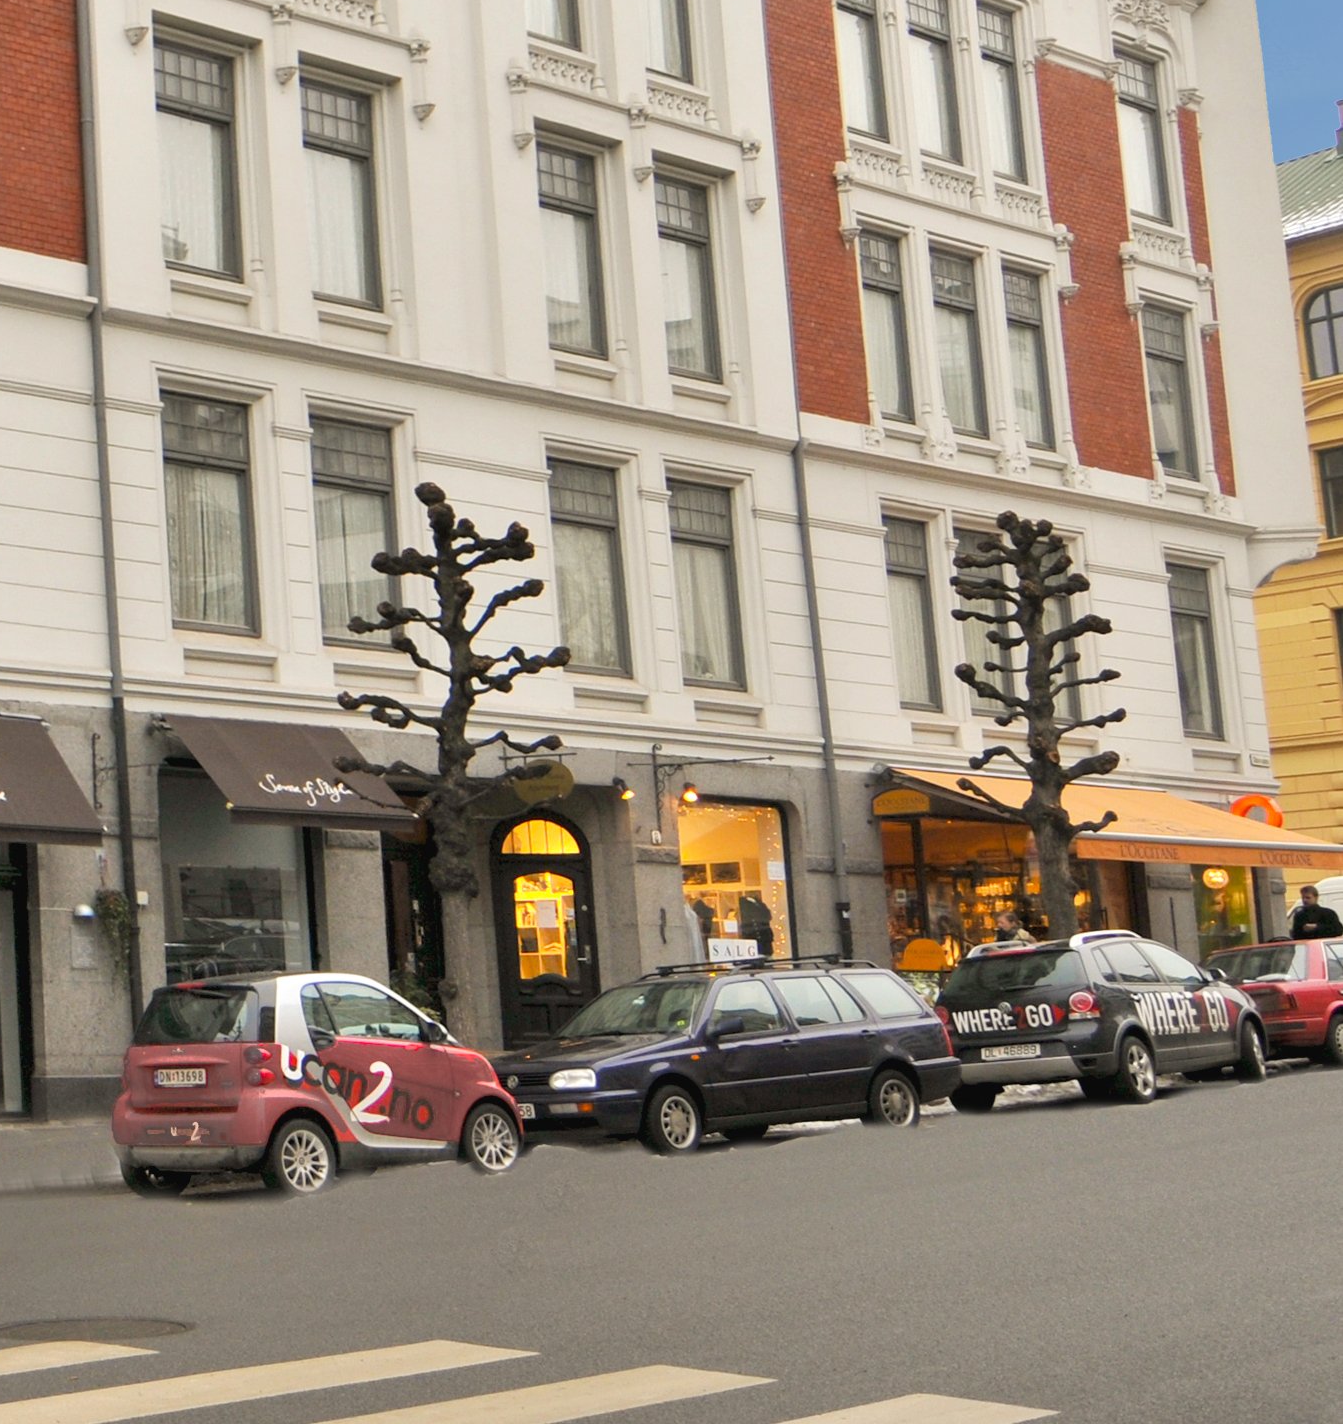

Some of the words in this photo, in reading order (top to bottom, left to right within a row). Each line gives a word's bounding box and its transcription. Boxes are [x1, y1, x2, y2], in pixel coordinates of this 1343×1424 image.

[303, 781, 317, 807] of
[1120, 842, 1179, 860] L'OCCITANE
[712, 944, 756, 957] SALG
[159, 1071, 172, 1083] DN
[176, 1070, 204, 1082] 13698
